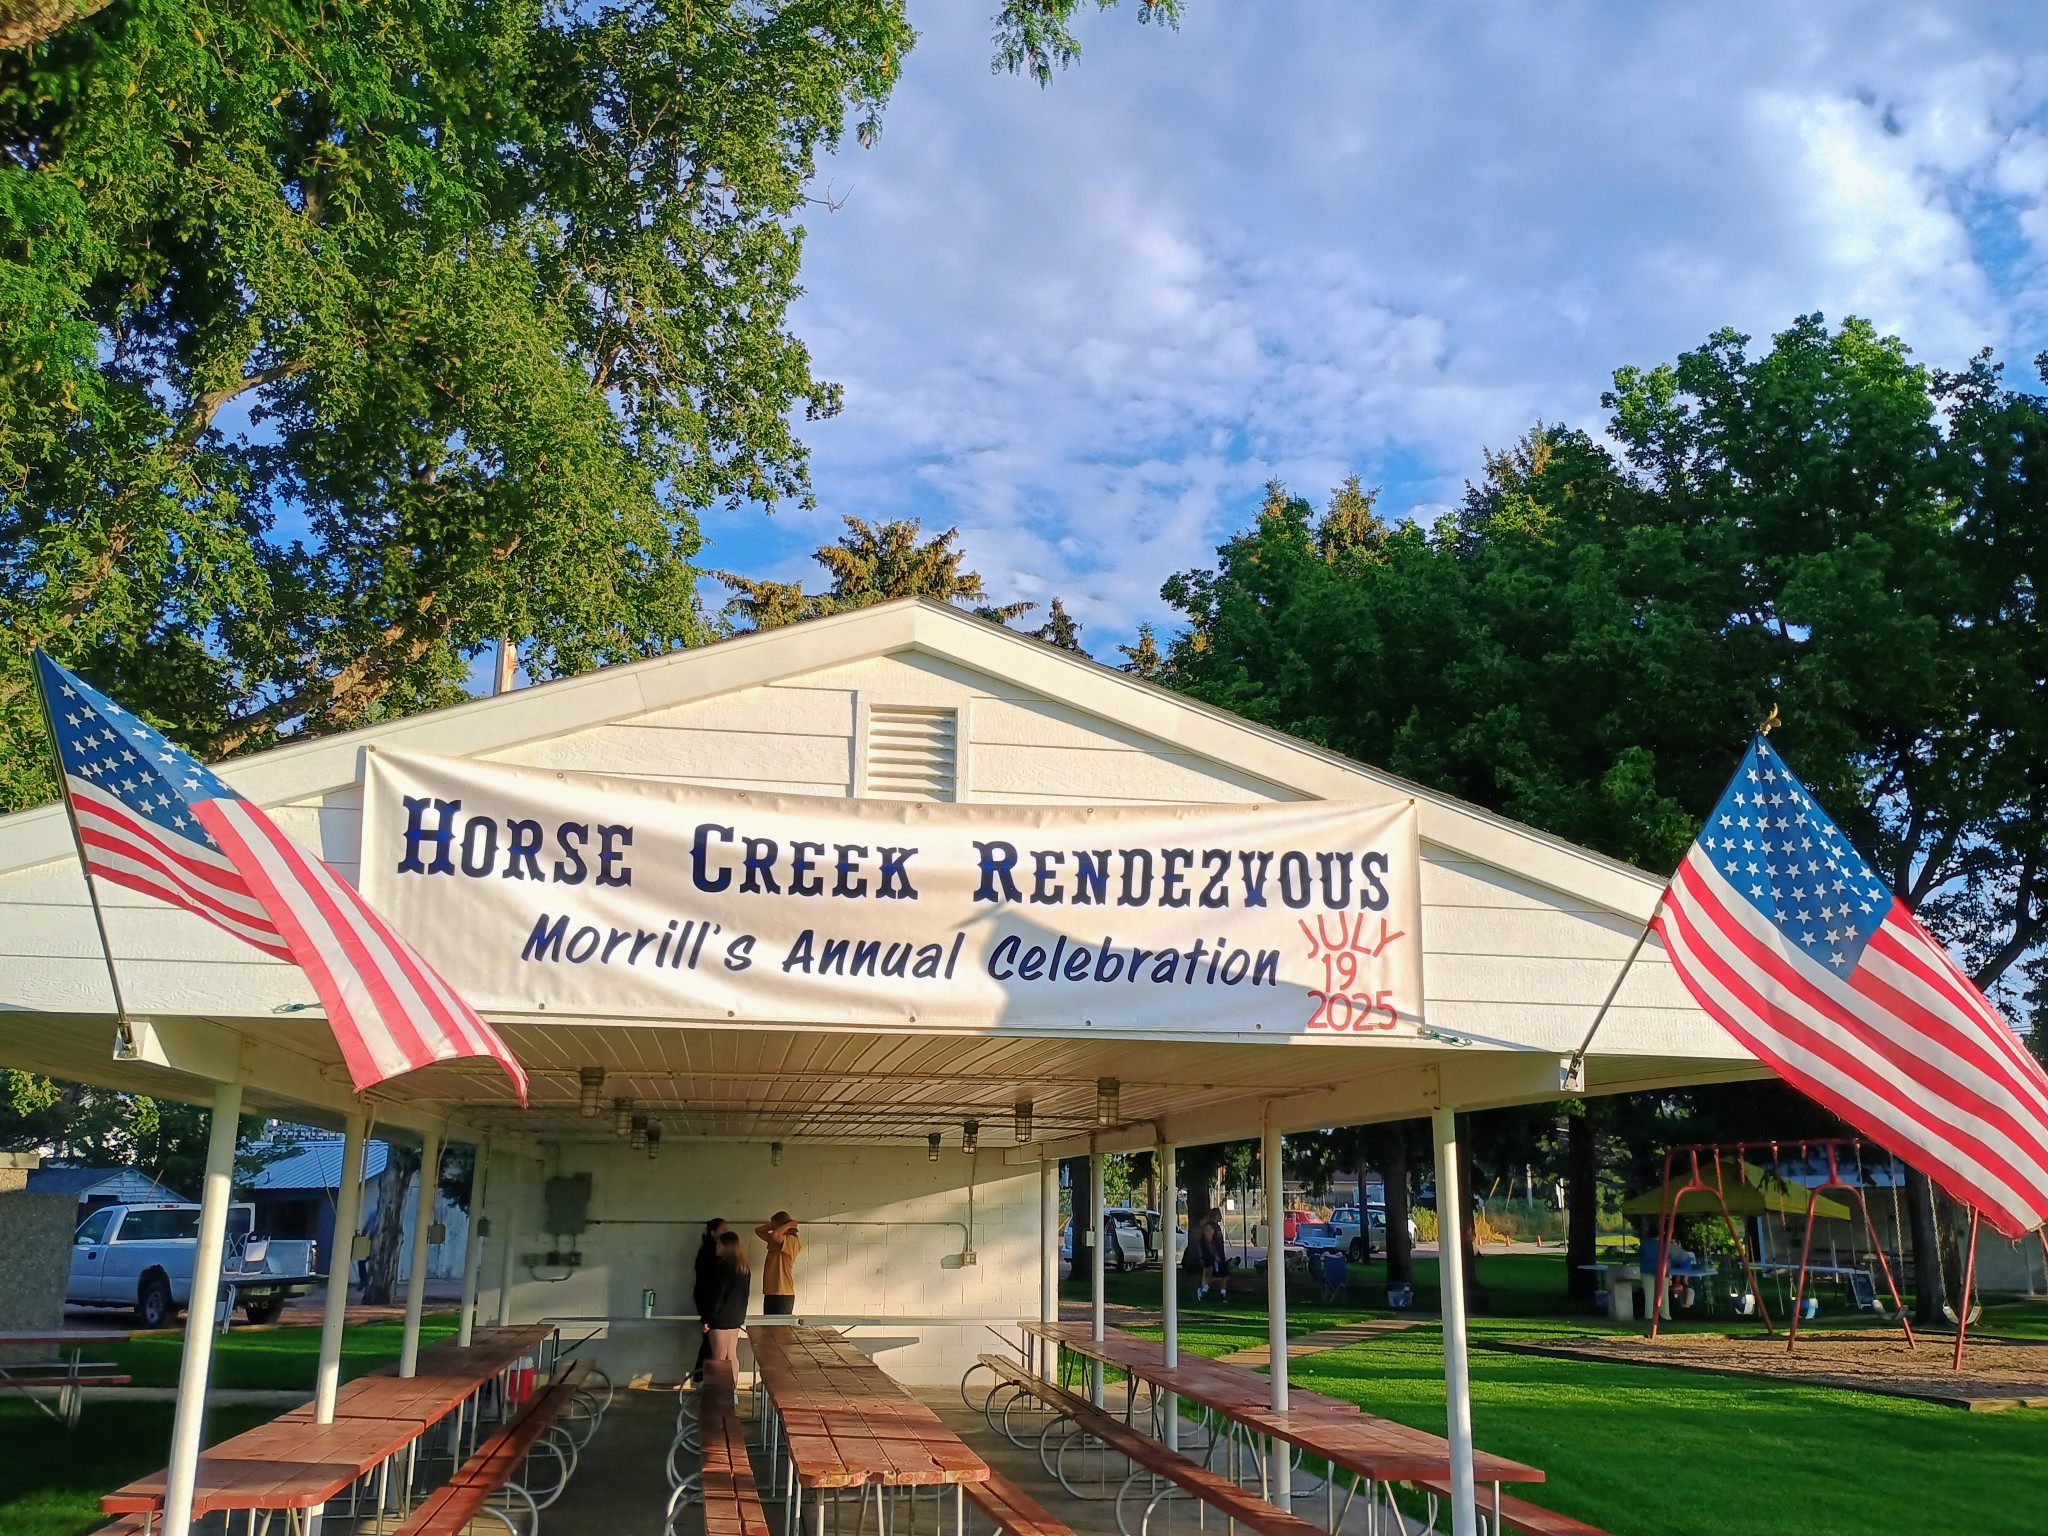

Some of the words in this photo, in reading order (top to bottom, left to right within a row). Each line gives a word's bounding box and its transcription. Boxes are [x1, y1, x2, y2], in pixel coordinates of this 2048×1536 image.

[397, 795, 633, 888] HORSE
[689, 823, 918, 900] CREEK
[973, 840, 1389, 911] RENDEZVOUS
[521, 913, 756, 971] Morrill's
[782, 930, 966, 980] Annual
[987, 935, 1280, 986] Celebration
[1298, 911, 1406, 959] JULY
[1321, 951, 1358, 993] 19
[1307, 989, 1398, 1032] 2025
